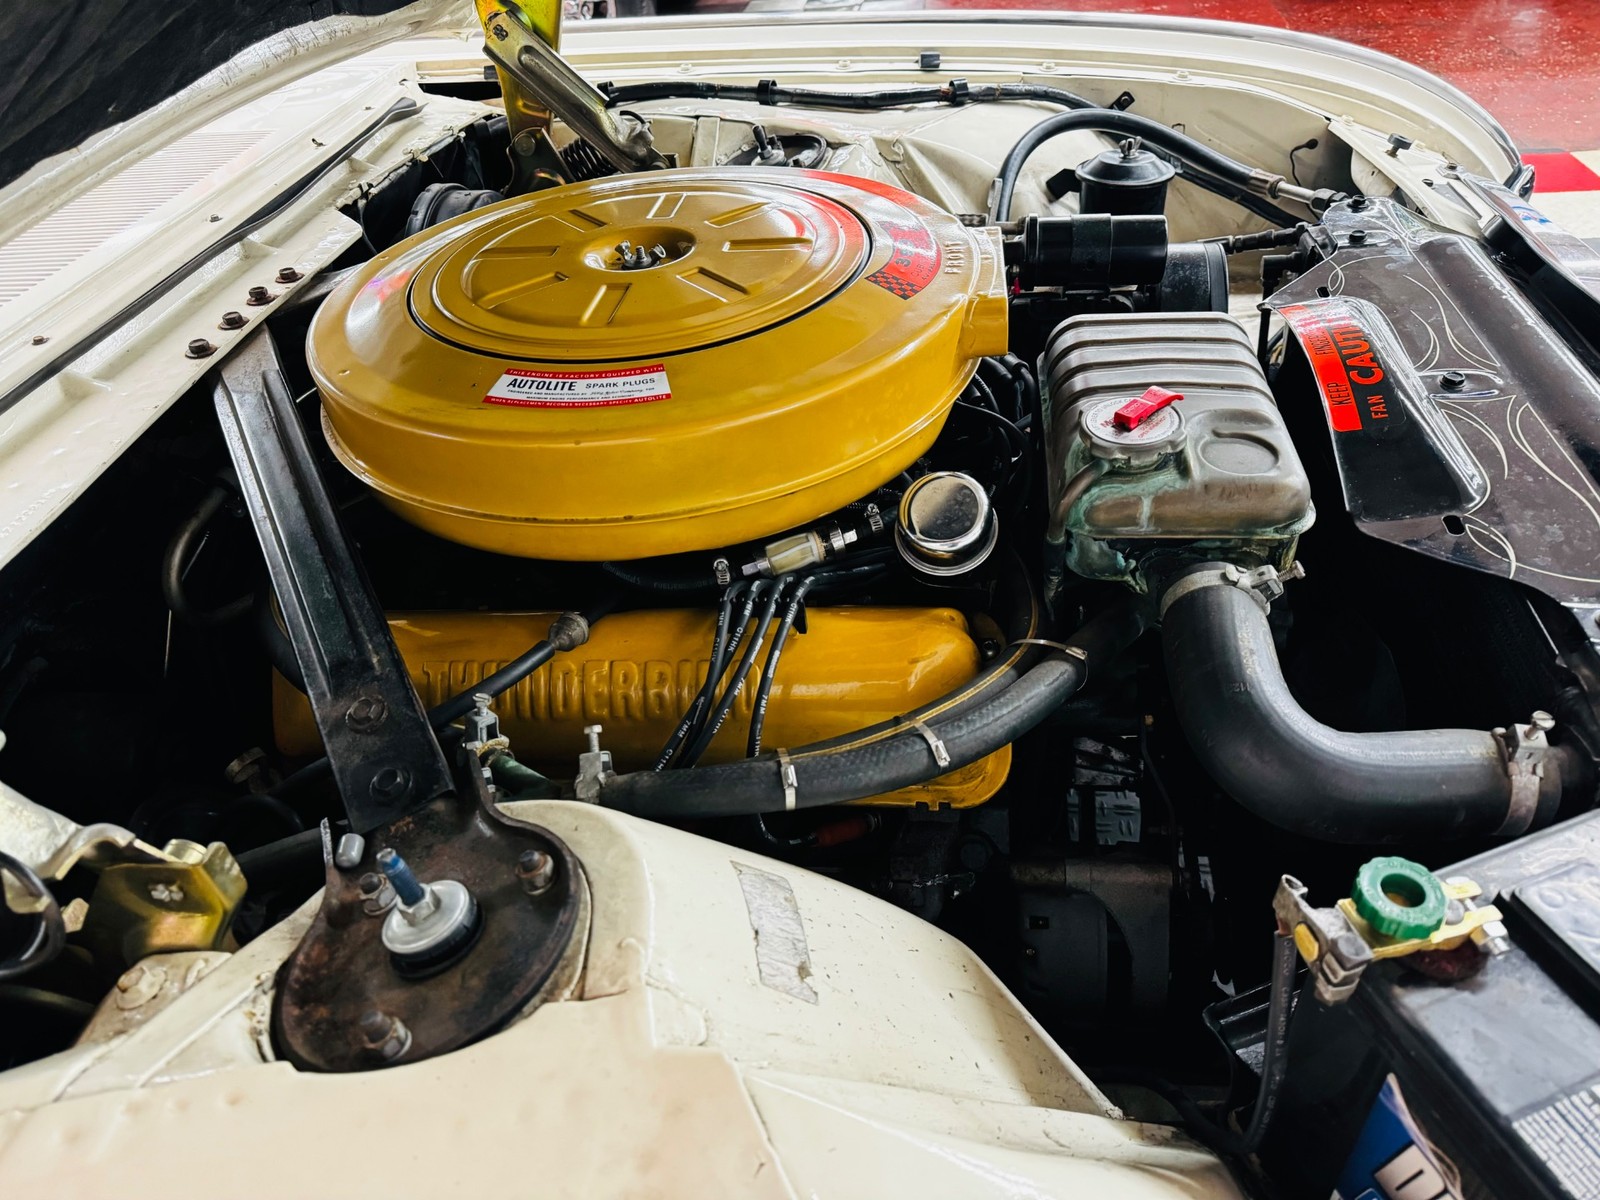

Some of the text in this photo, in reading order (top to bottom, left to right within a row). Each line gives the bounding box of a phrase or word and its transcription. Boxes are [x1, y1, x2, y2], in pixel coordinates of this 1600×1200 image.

[602, 369, 641, 378] EQUIPPED
[1331, 325, 1389, 419] FAN CAUTI
[506, 378, 577, 391] AUTOLITE
[585, 377, 656, 390] SPARK PLUGS
[633, 394, 667, 403] AUTOLITE
[1326, 382, 1352, 407] KEEP
[727, 626, 744, 653] C11HK
[760, 694, 769, 714] 7MM
[677, 719, 691, 738] 7MM
